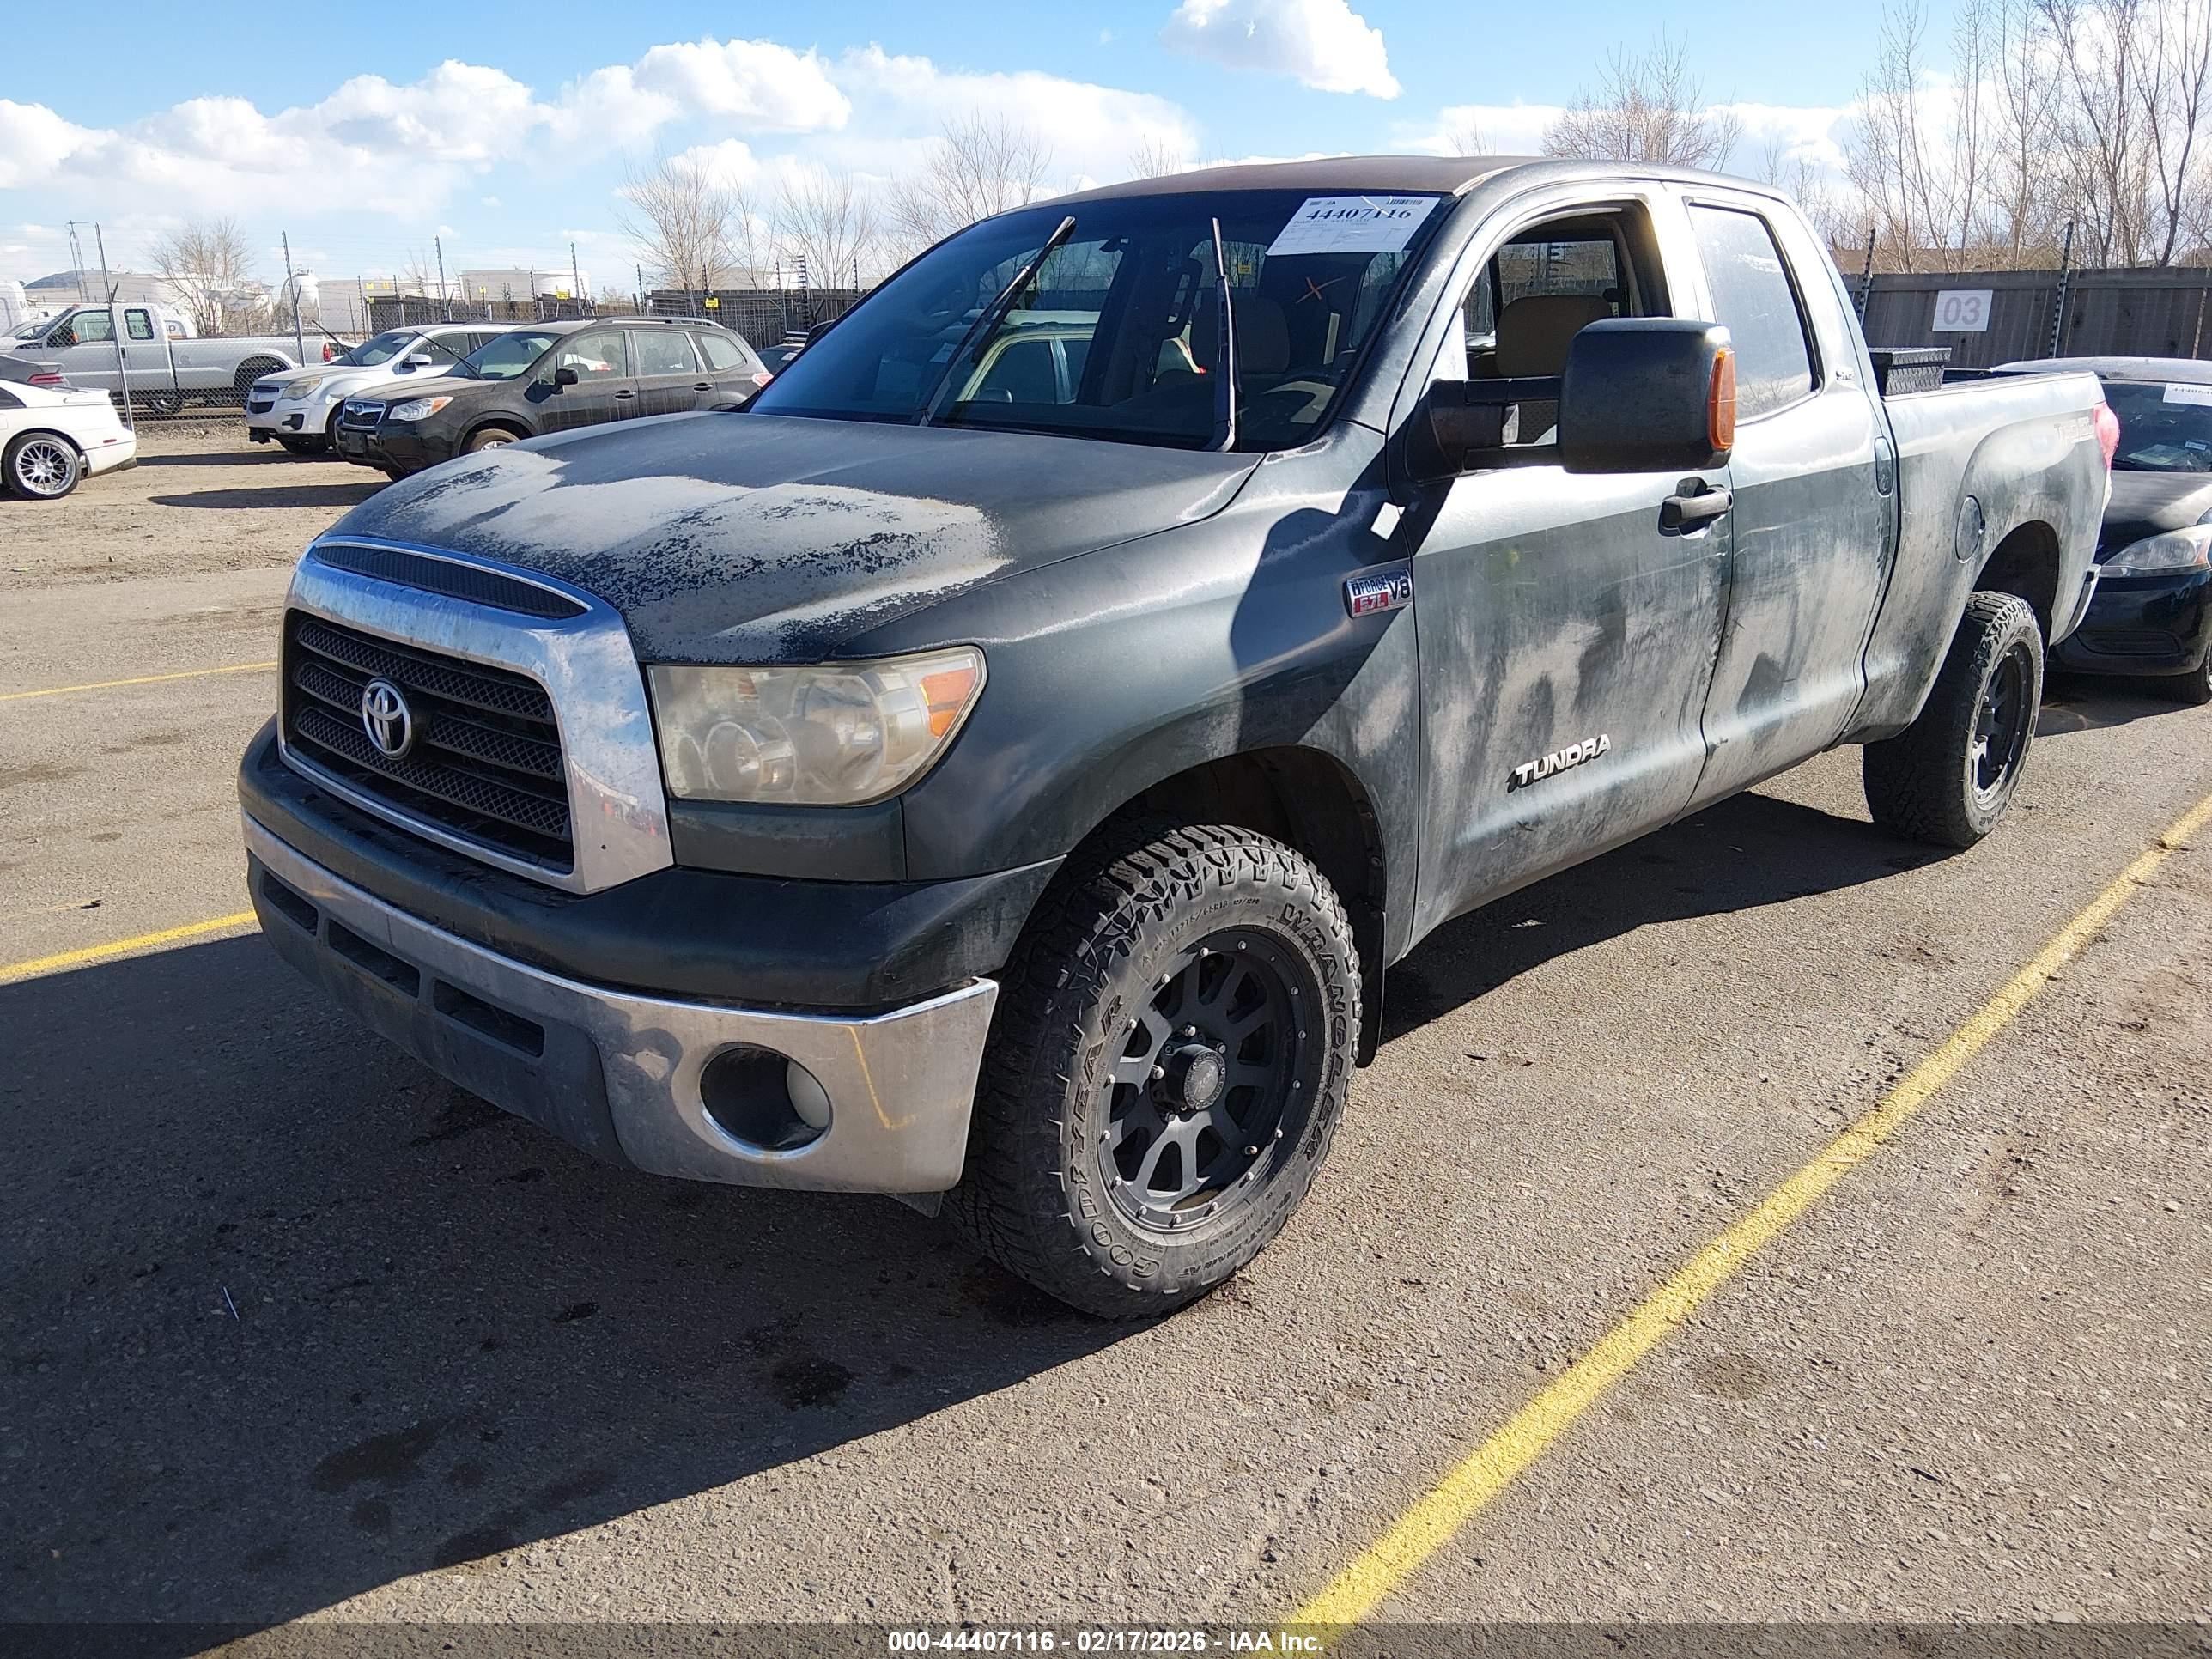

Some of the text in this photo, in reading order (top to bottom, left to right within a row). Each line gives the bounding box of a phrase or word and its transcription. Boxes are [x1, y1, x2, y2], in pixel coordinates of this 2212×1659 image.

[1306, 208, 1412, 220] 44407116
[1943, 296, 1981, 325] 03
[1388, 579, 1411, 600] V8
[1515, 733, 1612, 786] TUNDRA
[1279, 903, 1346, 1160] WRANGLER
[1070, 994, 1159, 1278] GOODYEAR
